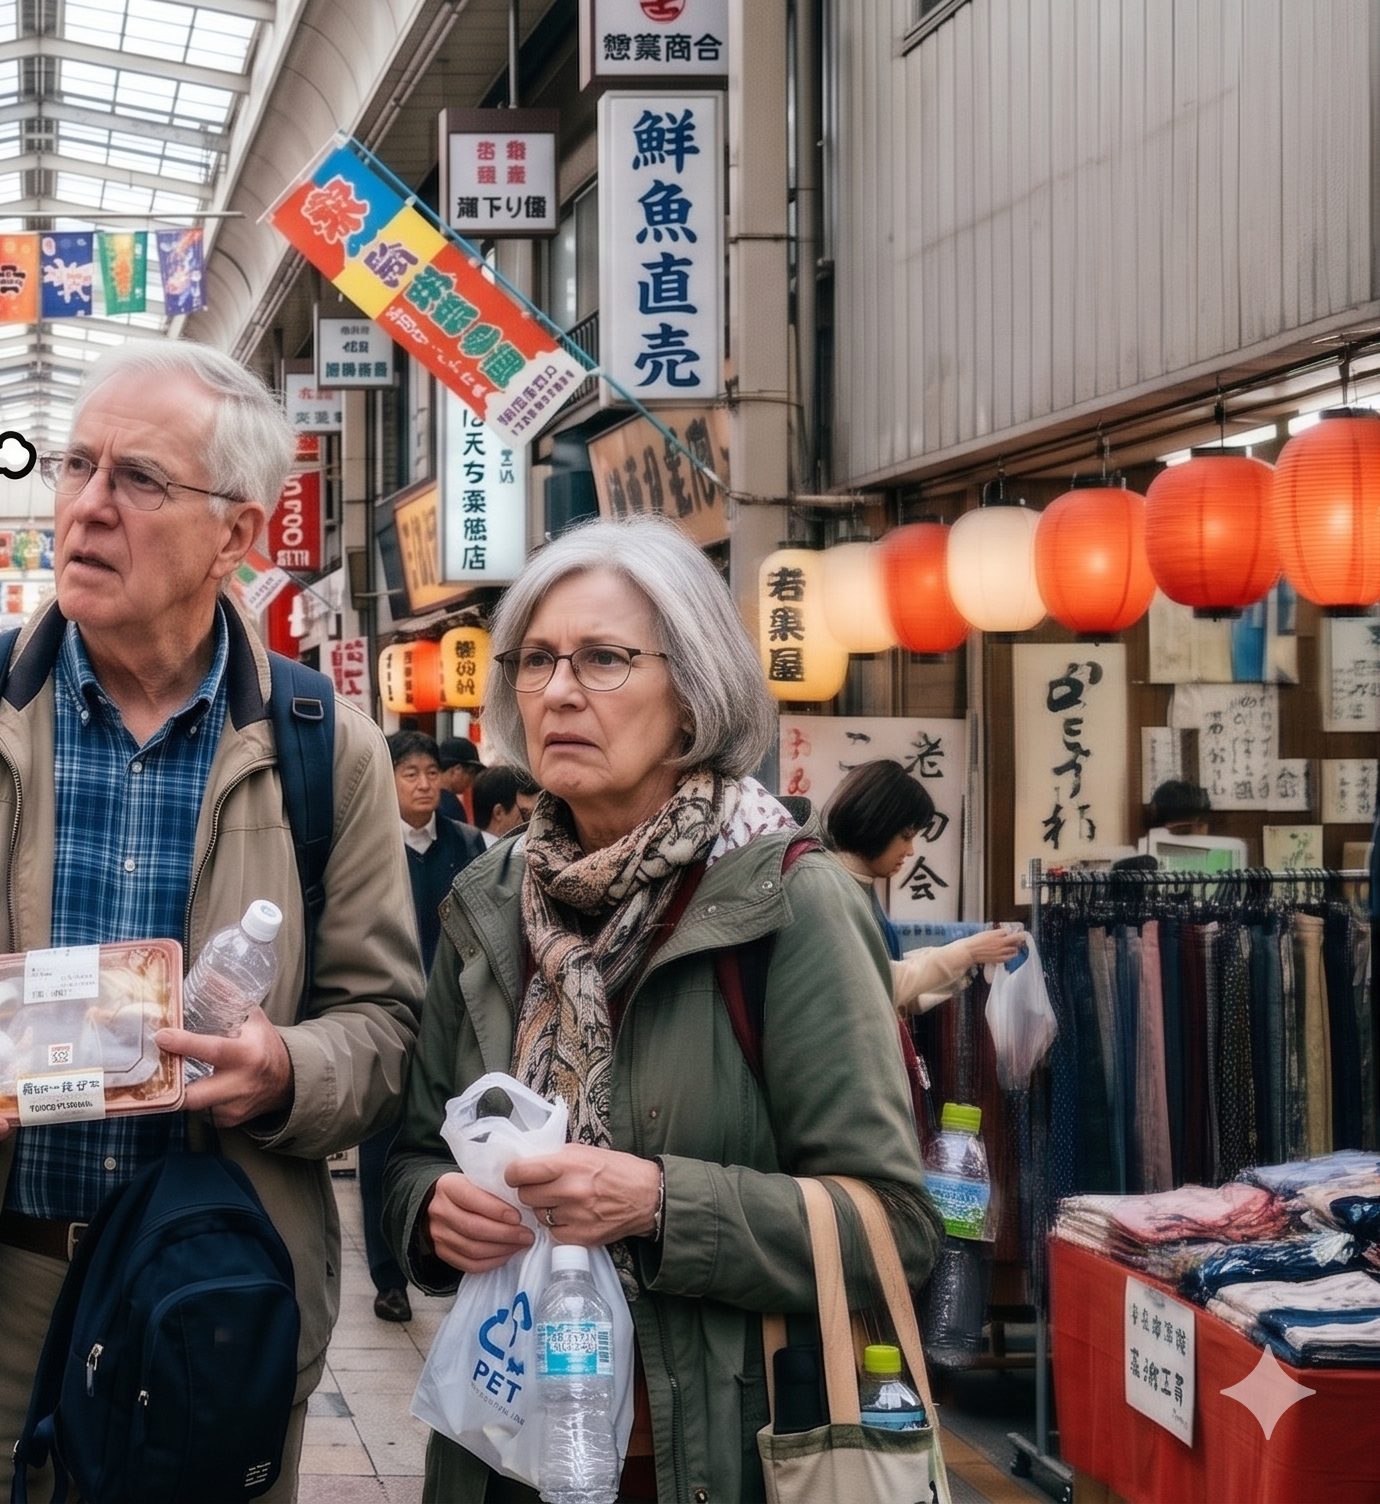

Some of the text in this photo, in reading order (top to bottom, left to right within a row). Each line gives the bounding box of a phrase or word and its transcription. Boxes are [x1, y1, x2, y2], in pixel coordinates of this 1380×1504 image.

[631, 108, 702, 388] 鮮魚直売
[472, 1359, 523, 1404] PET
